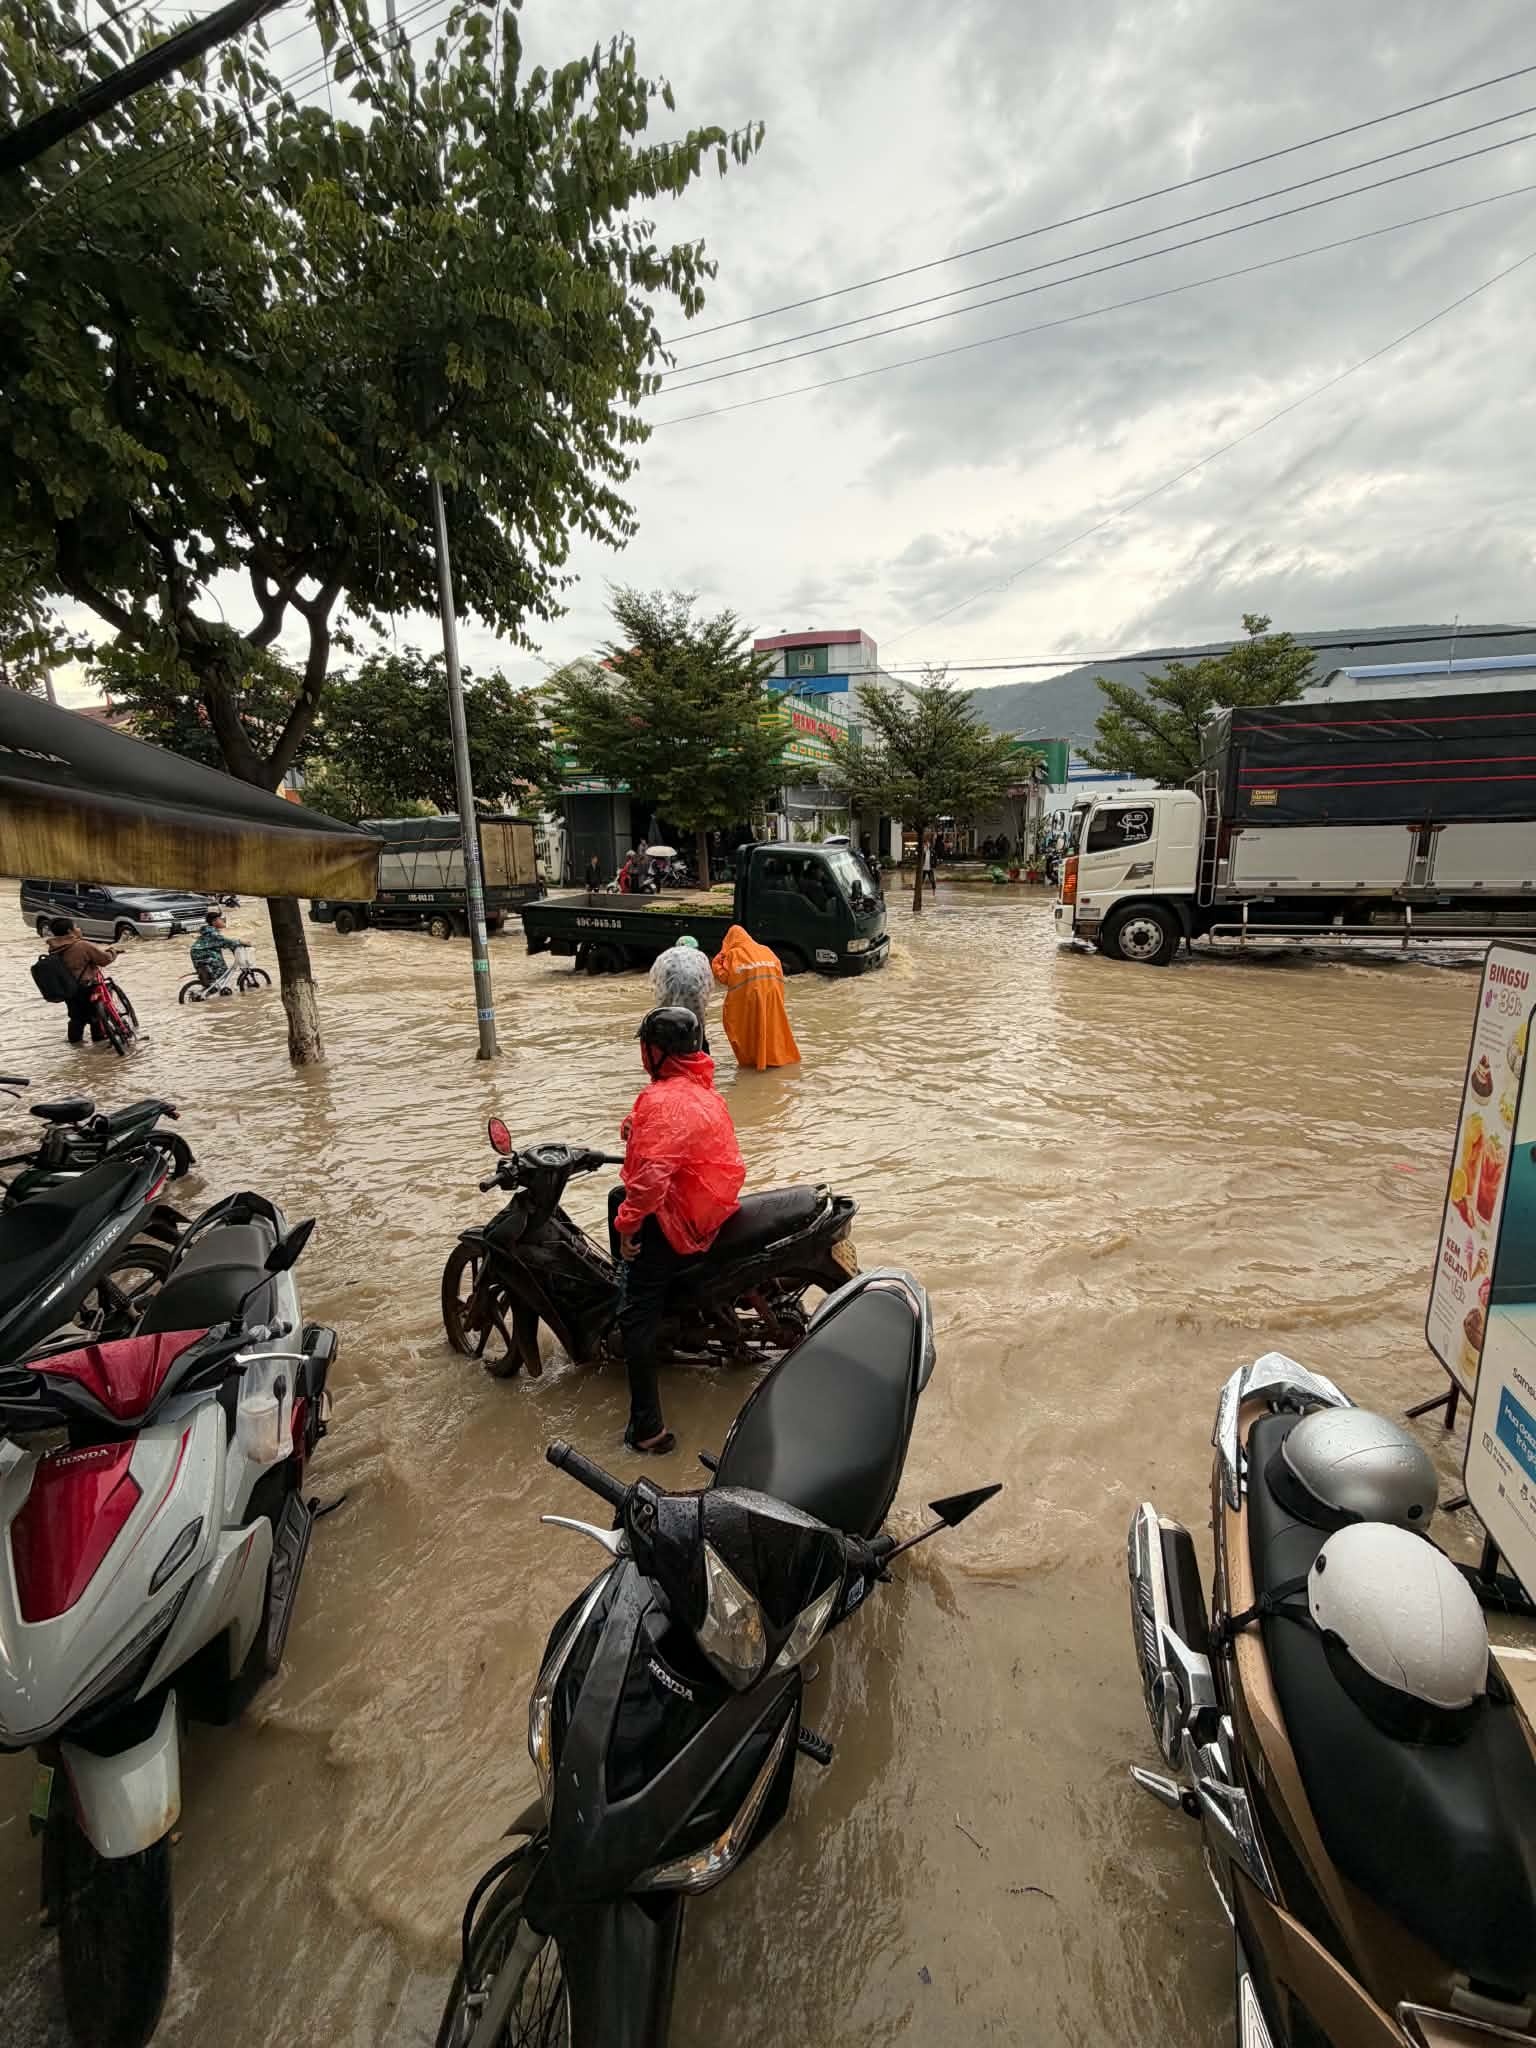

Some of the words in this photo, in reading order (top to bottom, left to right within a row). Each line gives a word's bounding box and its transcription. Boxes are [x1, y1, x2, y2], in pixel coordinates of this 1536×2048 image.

[1489, 963, 1530, 991] BINGSU
[1445, 1235, 1461, 1258] KEM
[1443, 1251, 1468, 1282] GELATO
[55, 1448, 109, 1467] HONDA
[648, 1657, 694, 1702] HONDA
